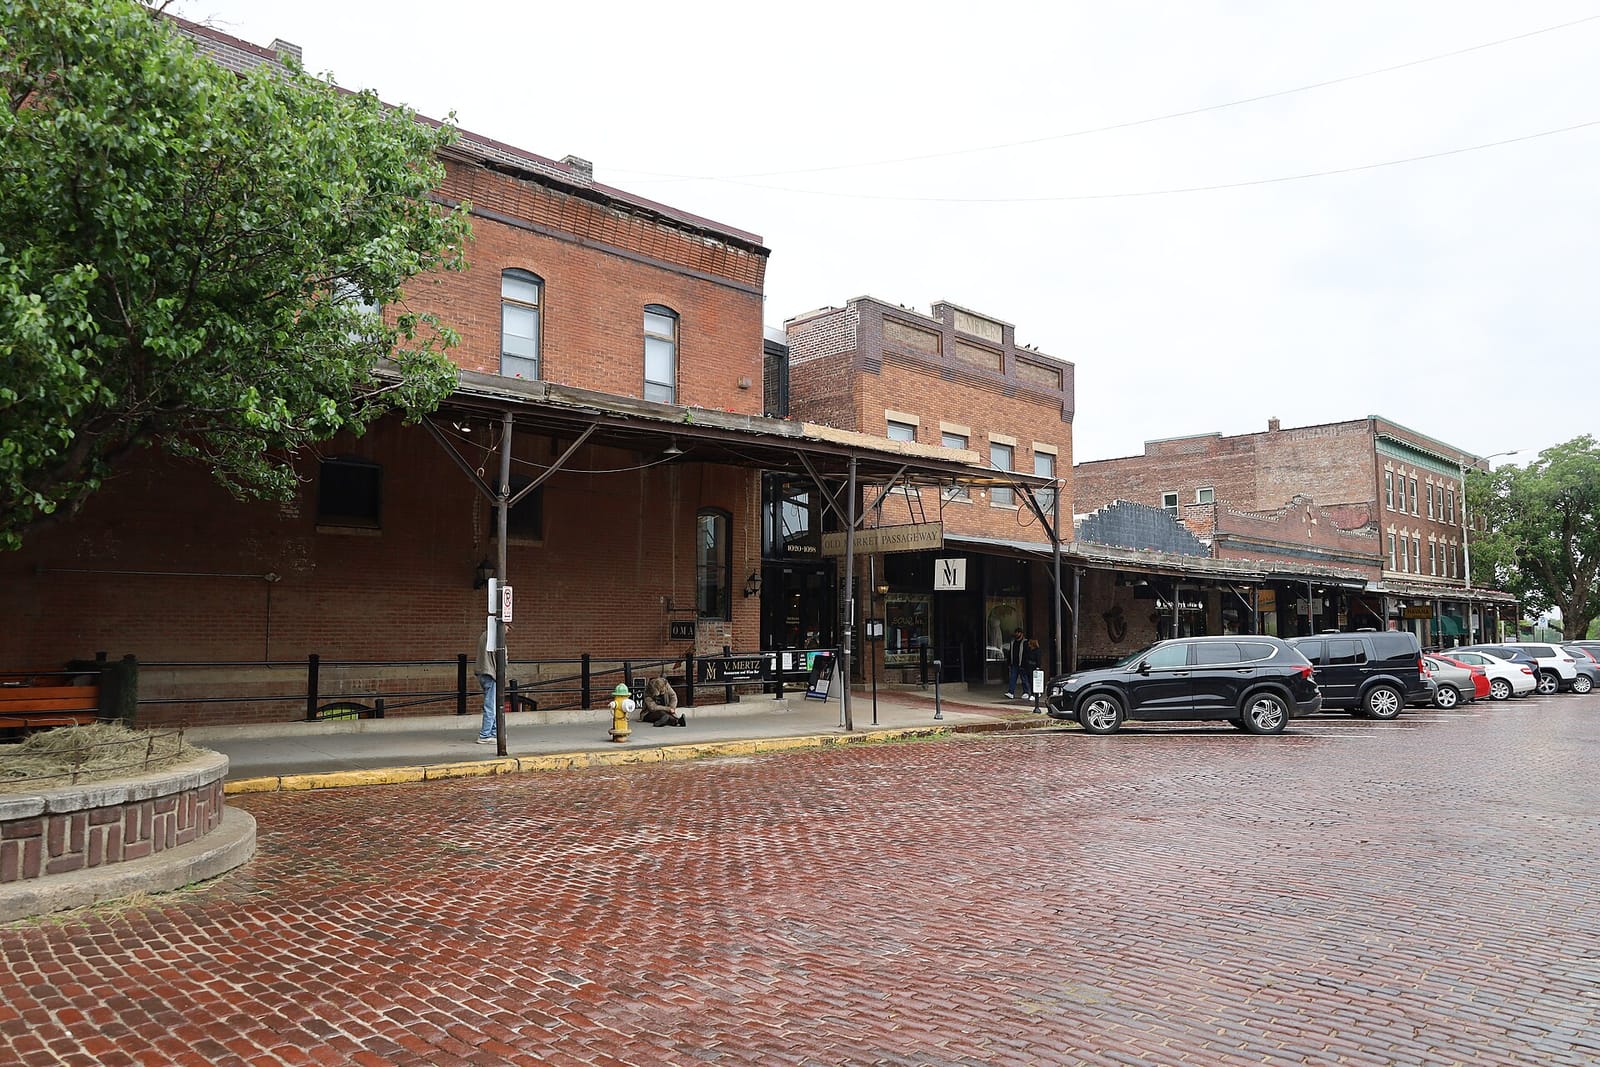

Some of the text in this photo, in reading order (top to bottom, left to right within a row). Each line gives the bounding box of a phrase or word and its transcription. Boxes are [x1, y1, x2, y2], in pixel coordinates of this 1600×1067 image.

[824, 531, 938, 550] OLD ARKET PASSAGEWAY
[732, 660, 761, 670] MERTZ
